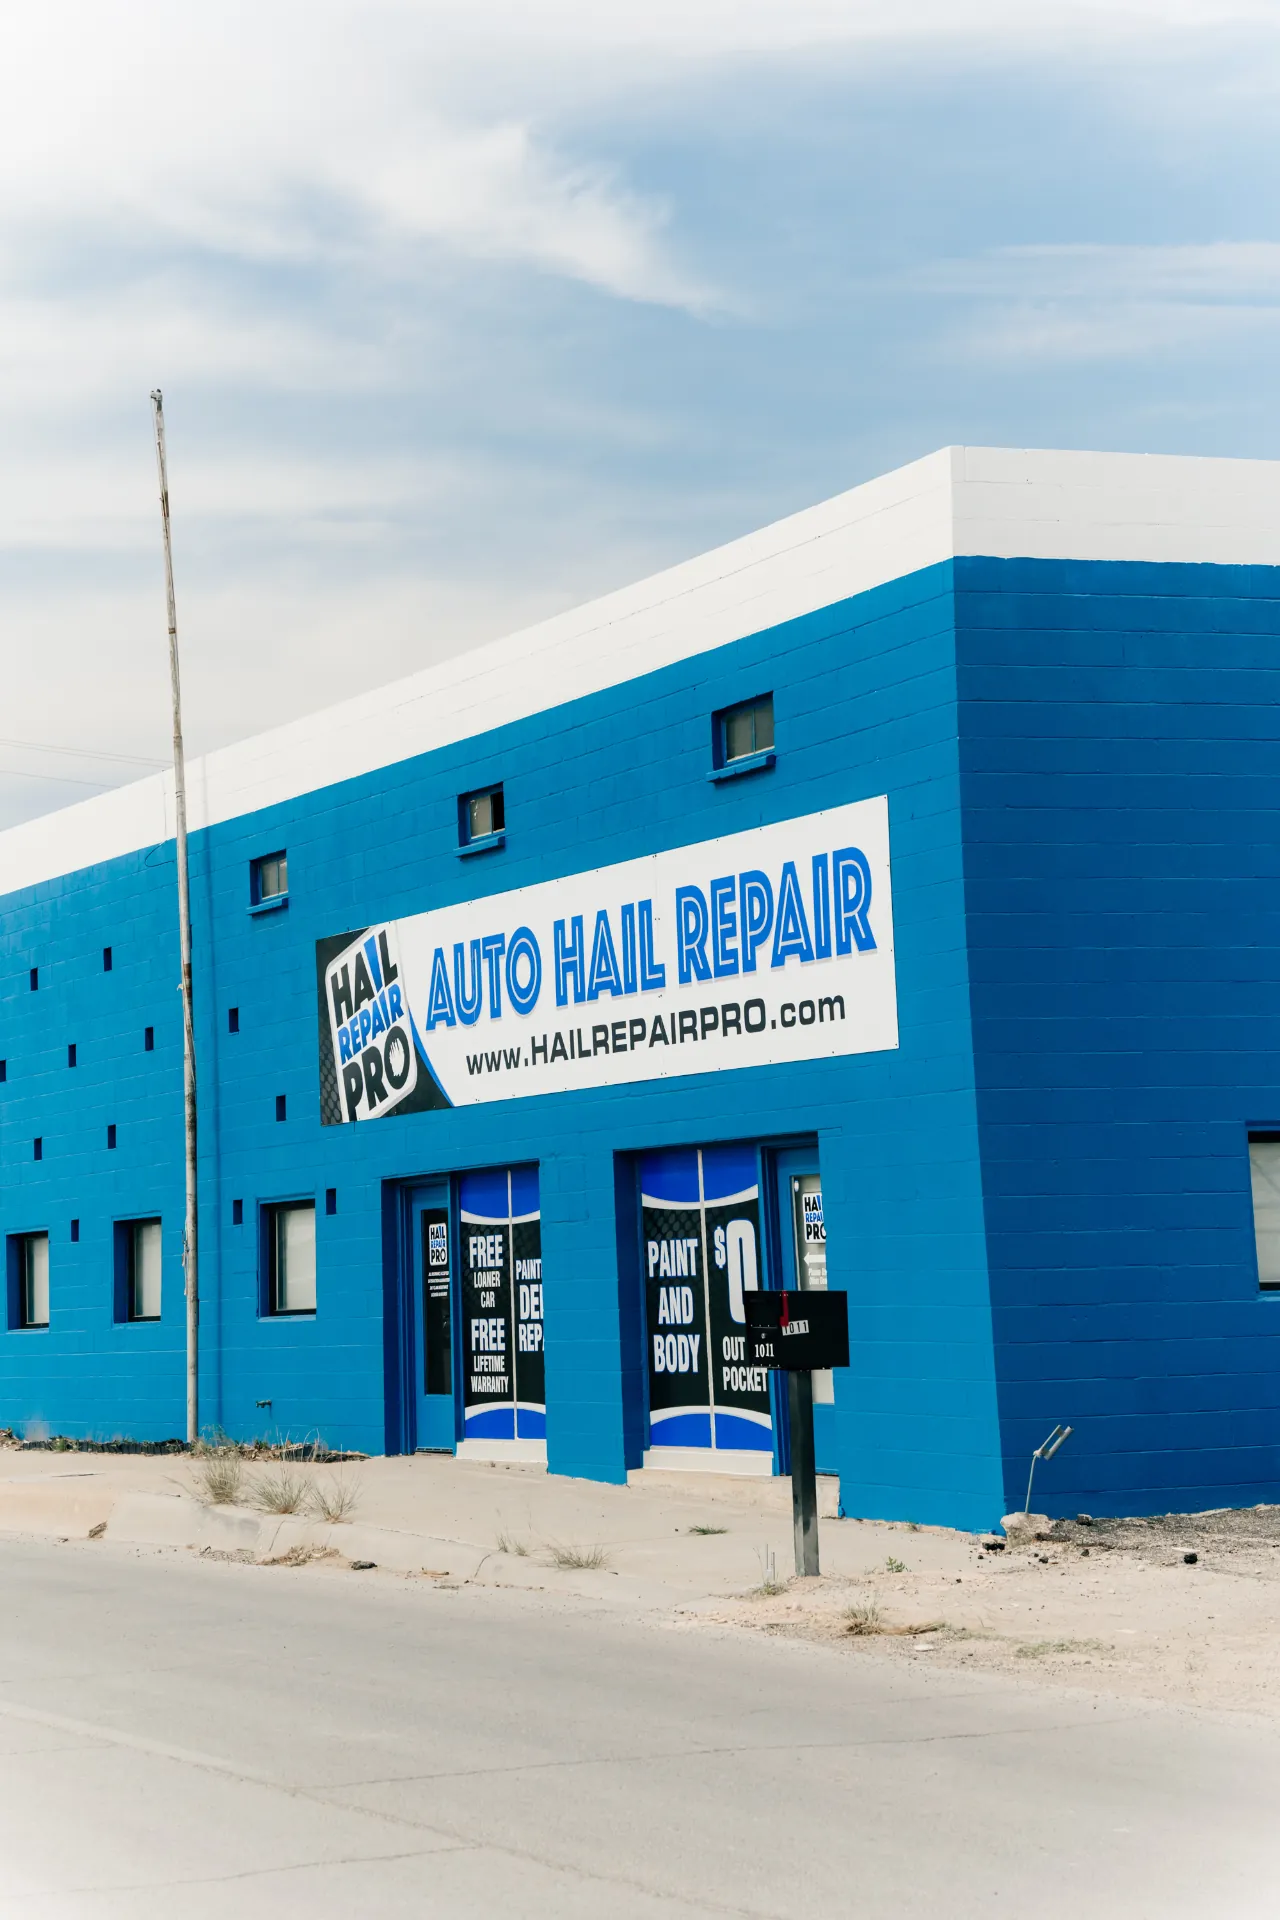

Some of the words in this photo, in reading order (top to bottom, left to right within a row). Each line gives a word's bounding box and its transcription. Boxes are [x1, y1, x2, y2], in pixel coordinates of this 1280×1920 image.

[426, 926, 541, 1031] AUTO
[553, 898, 666, 1008] HAIL
[675, 846, 878, 985] REPAIR
[331, 929, 398, 1028] HAIL
[338, 983, 404, 1065] REPAIR
[466, 994, 846, 1076] www.HAILREPAIRPRO.com
[342, 1025, 410, 1121] PRO
[804, 1195, 822, 1212] HAI
[805, 1212, 823, 1222] REPAI
[430, 1225, 446, 1240] HAIL
[806, 1223, 827, 1240] PRO
[431, 1248, 447, 1262] PRO
[469, 1234, 503, 1269] FREE
[648, 1238, 698, 1278] PAINT
[474, 1270, 501, 1288] LOANER
[516, 1259, 542, 1280] PAINT
[714, 1219, 759, 1324] $0
[480, 1291, 496, 1308] CAR
[519, 1284, 544, 1321] DE
[658, 1286, 694, 1325] AND
[471, 1318, 506, 1351] FREE
[519, 1323, 545, 1352] REP
[784, 1321, 808, 1334] 1011
[653, 1333, 700, 1374] BODY
[722, 1336, 745, 1361] OUT
[754, 1343, 774, 1358] 1011
[473, 1355, 505, 1373] LIFETIME
[471, 1375, 509, 1393] WARRANTY
[722, 1366, 767, 1392] POCKET
